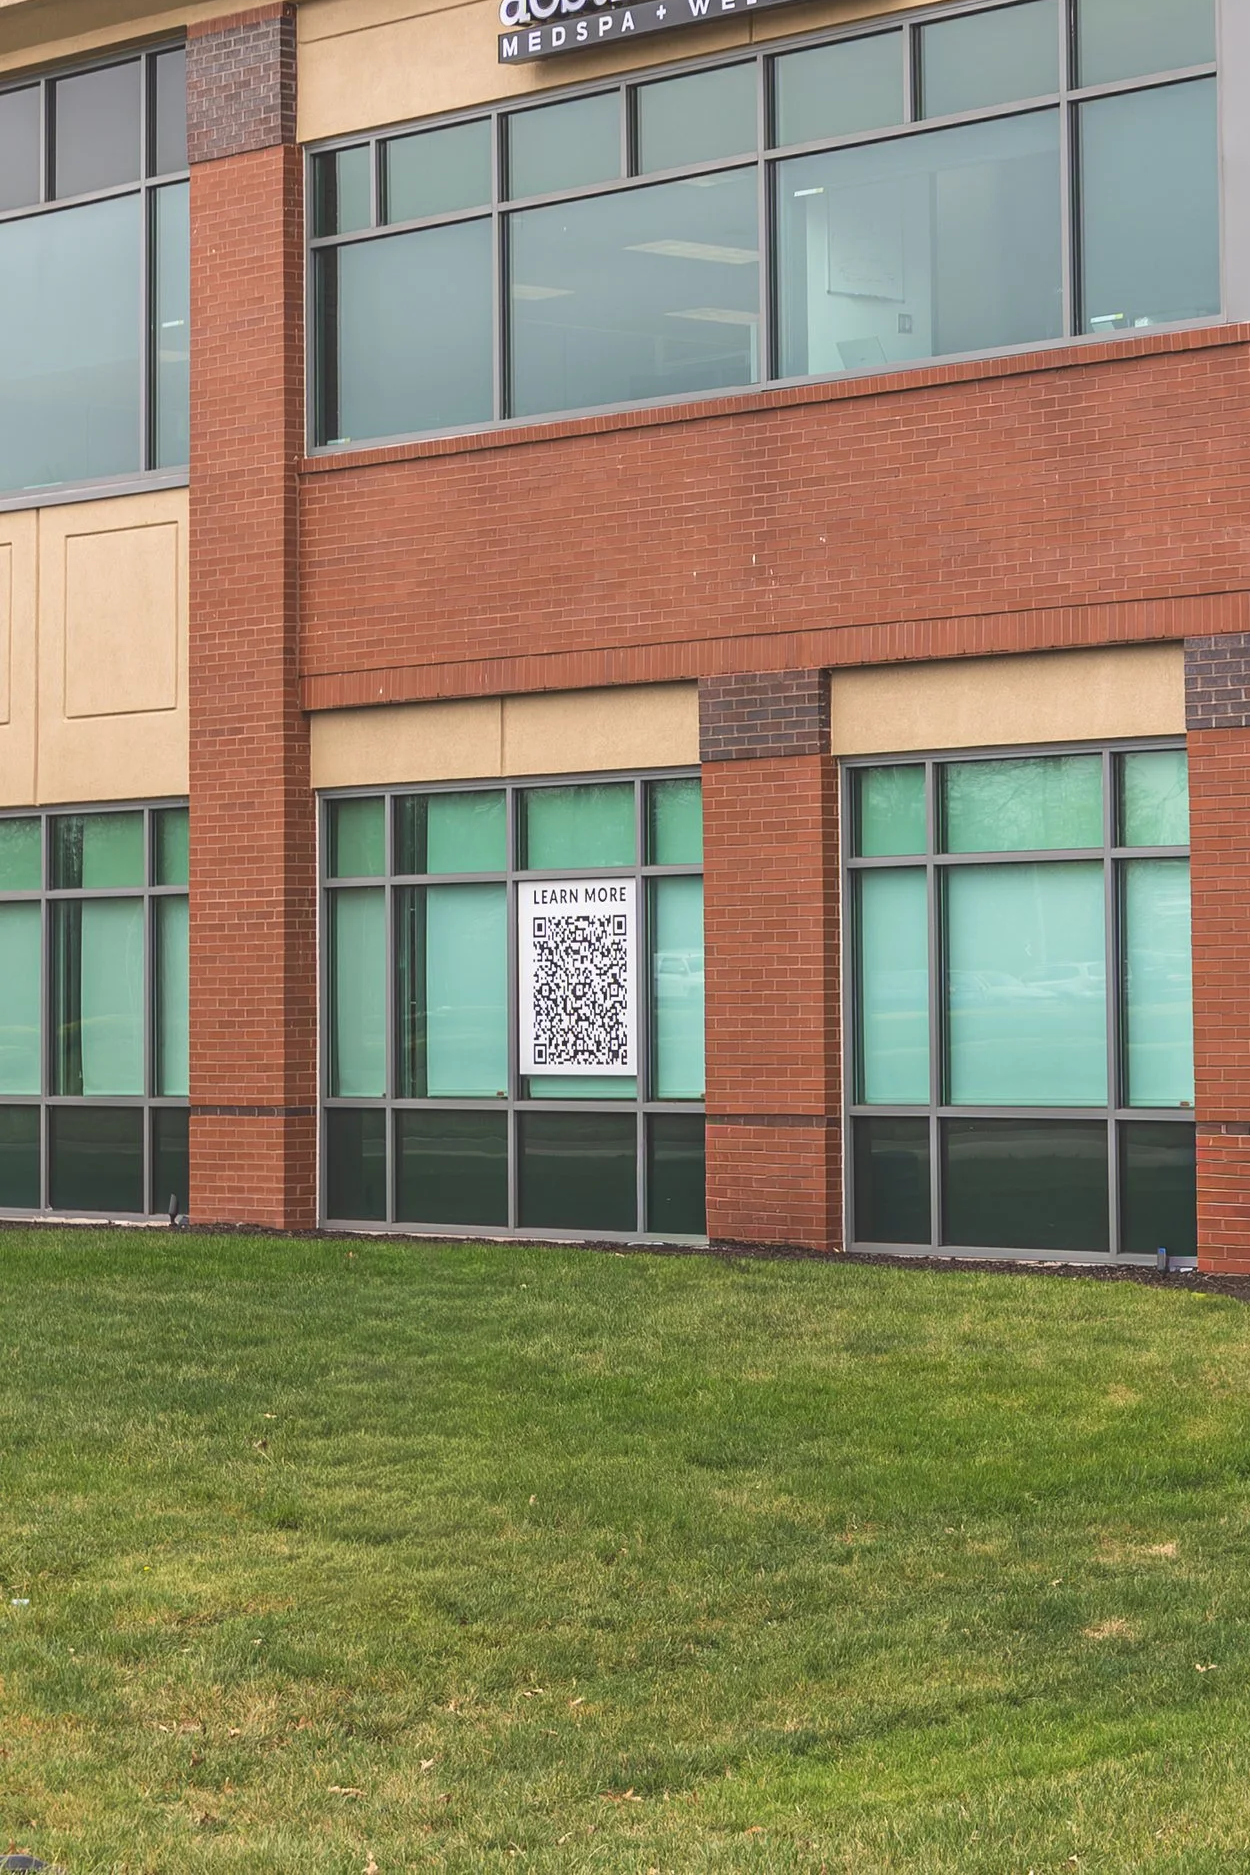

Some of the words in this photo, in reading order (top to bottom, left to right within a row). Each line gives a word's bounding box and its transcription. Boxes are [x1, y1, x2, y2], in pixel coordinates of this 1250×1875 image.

[503, 11, 635, 58] MEDSPA
[533, 889, 579, 905] LEARN
[584, 887, 627, 903] MORE
